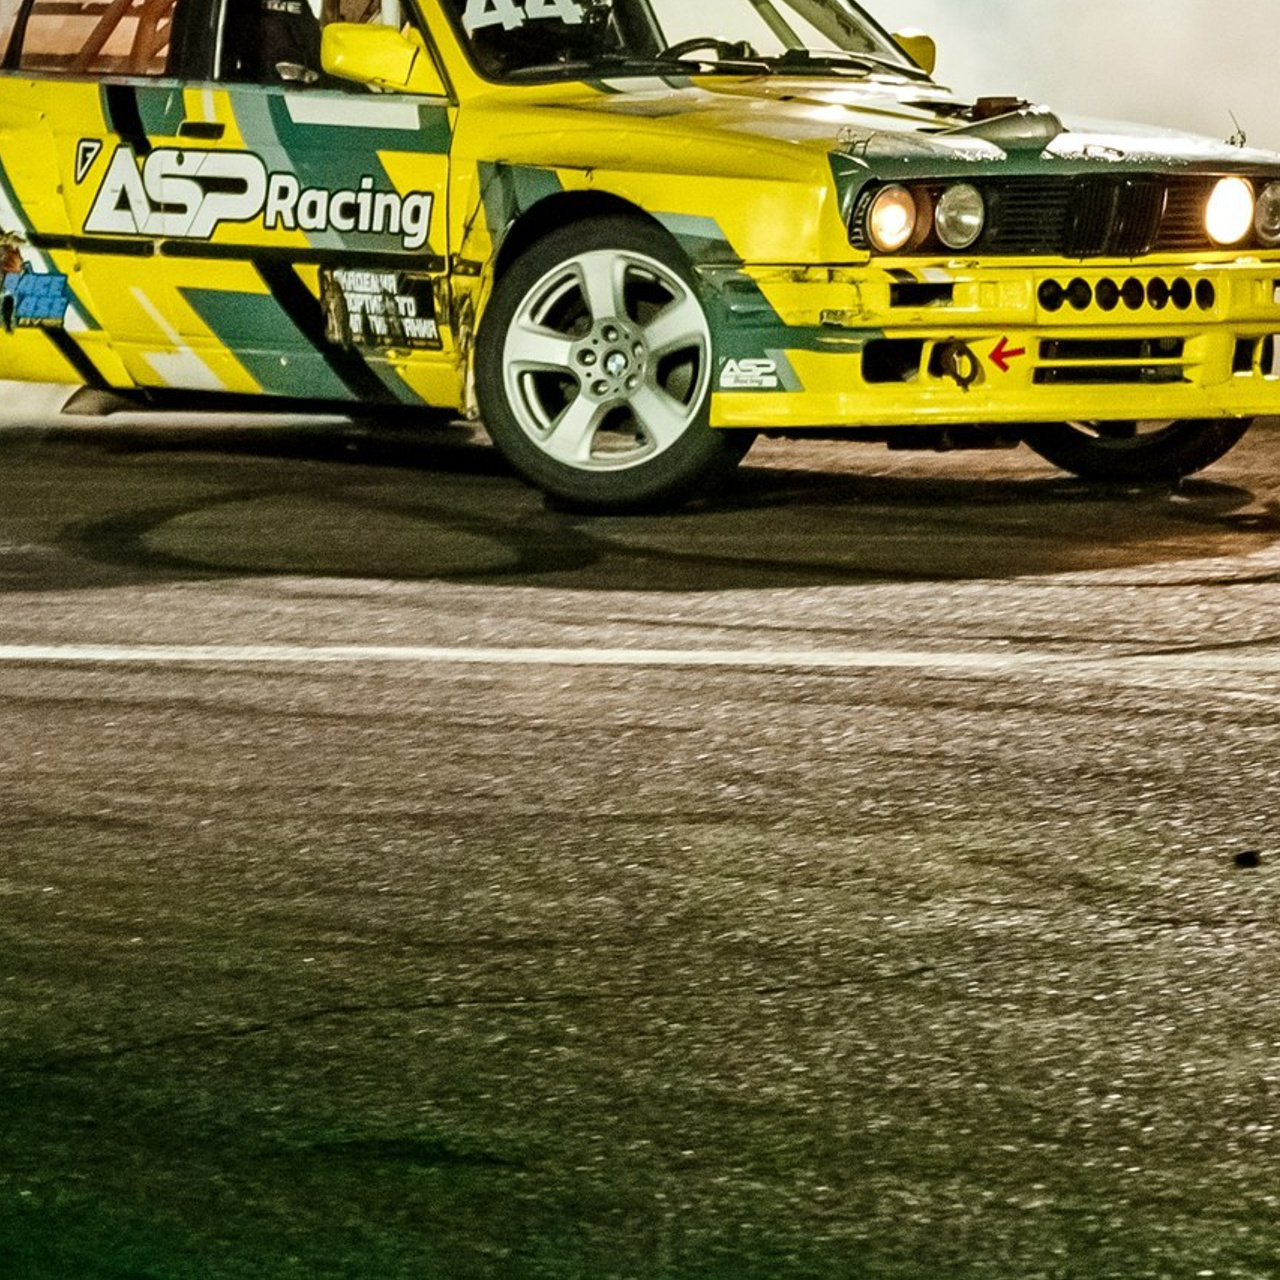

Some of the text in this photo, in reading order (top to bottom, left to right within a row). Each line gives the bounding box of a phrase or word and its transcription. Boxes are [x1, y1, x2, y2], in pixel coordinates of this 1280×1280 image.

[83, 146, 433, 248] ASP Racing
[721, 358, 776, 376] ASP
